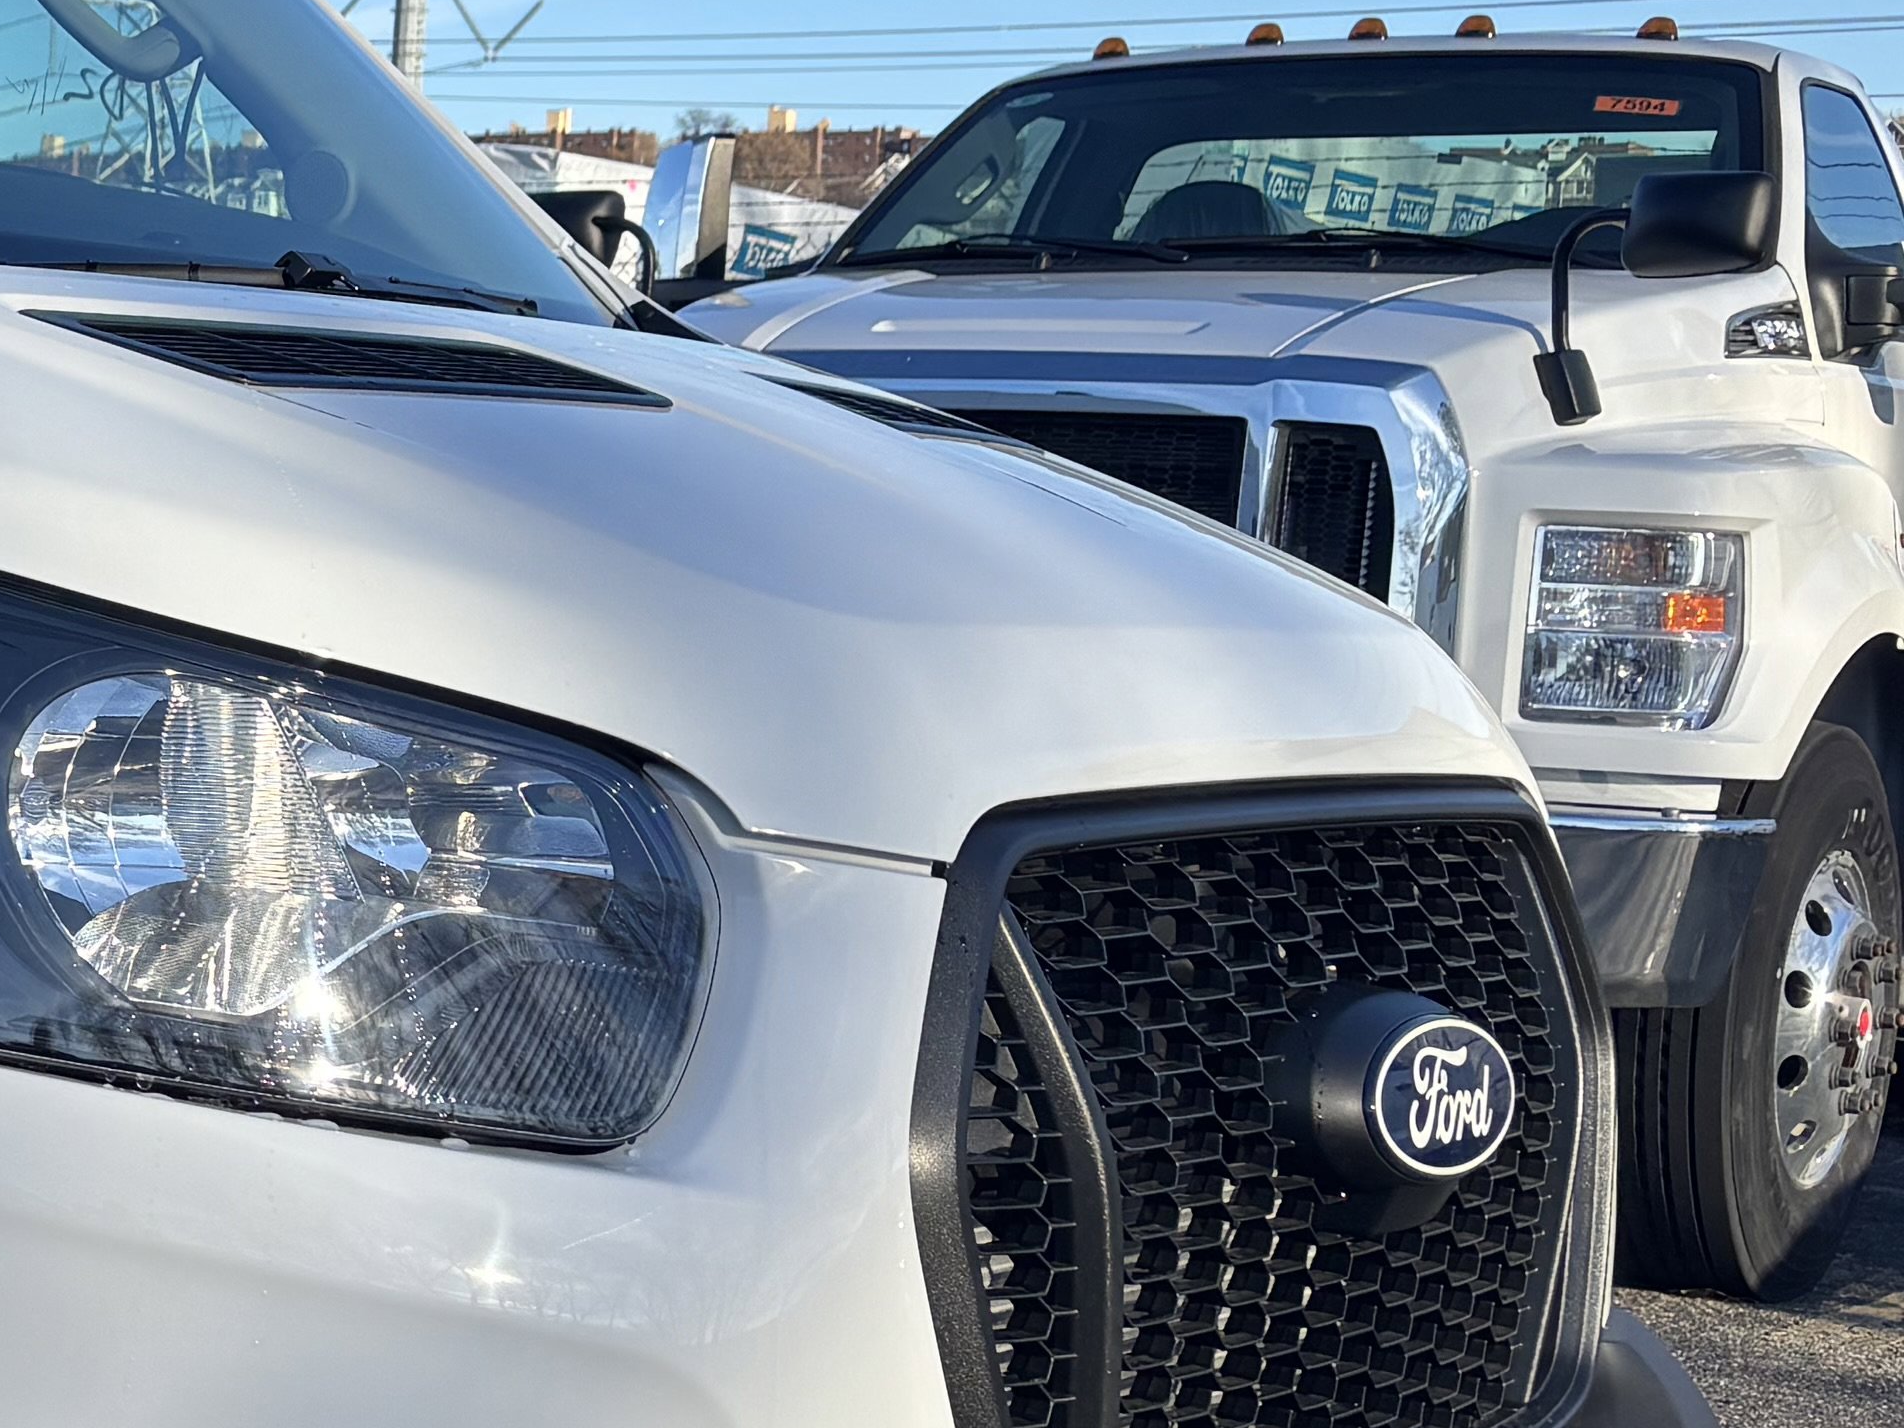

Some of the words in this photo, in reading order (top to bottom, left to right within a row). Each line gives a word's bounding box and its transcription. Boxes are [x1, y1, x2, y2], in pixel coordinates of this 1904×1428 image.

[1610, 98, 1666, 112] 7594
[1331, 177, 1375, 213] TOLKO
[1395, 191, 1437, 225] TOLKO
[1408, 1044, 1494, 1149] Ford
